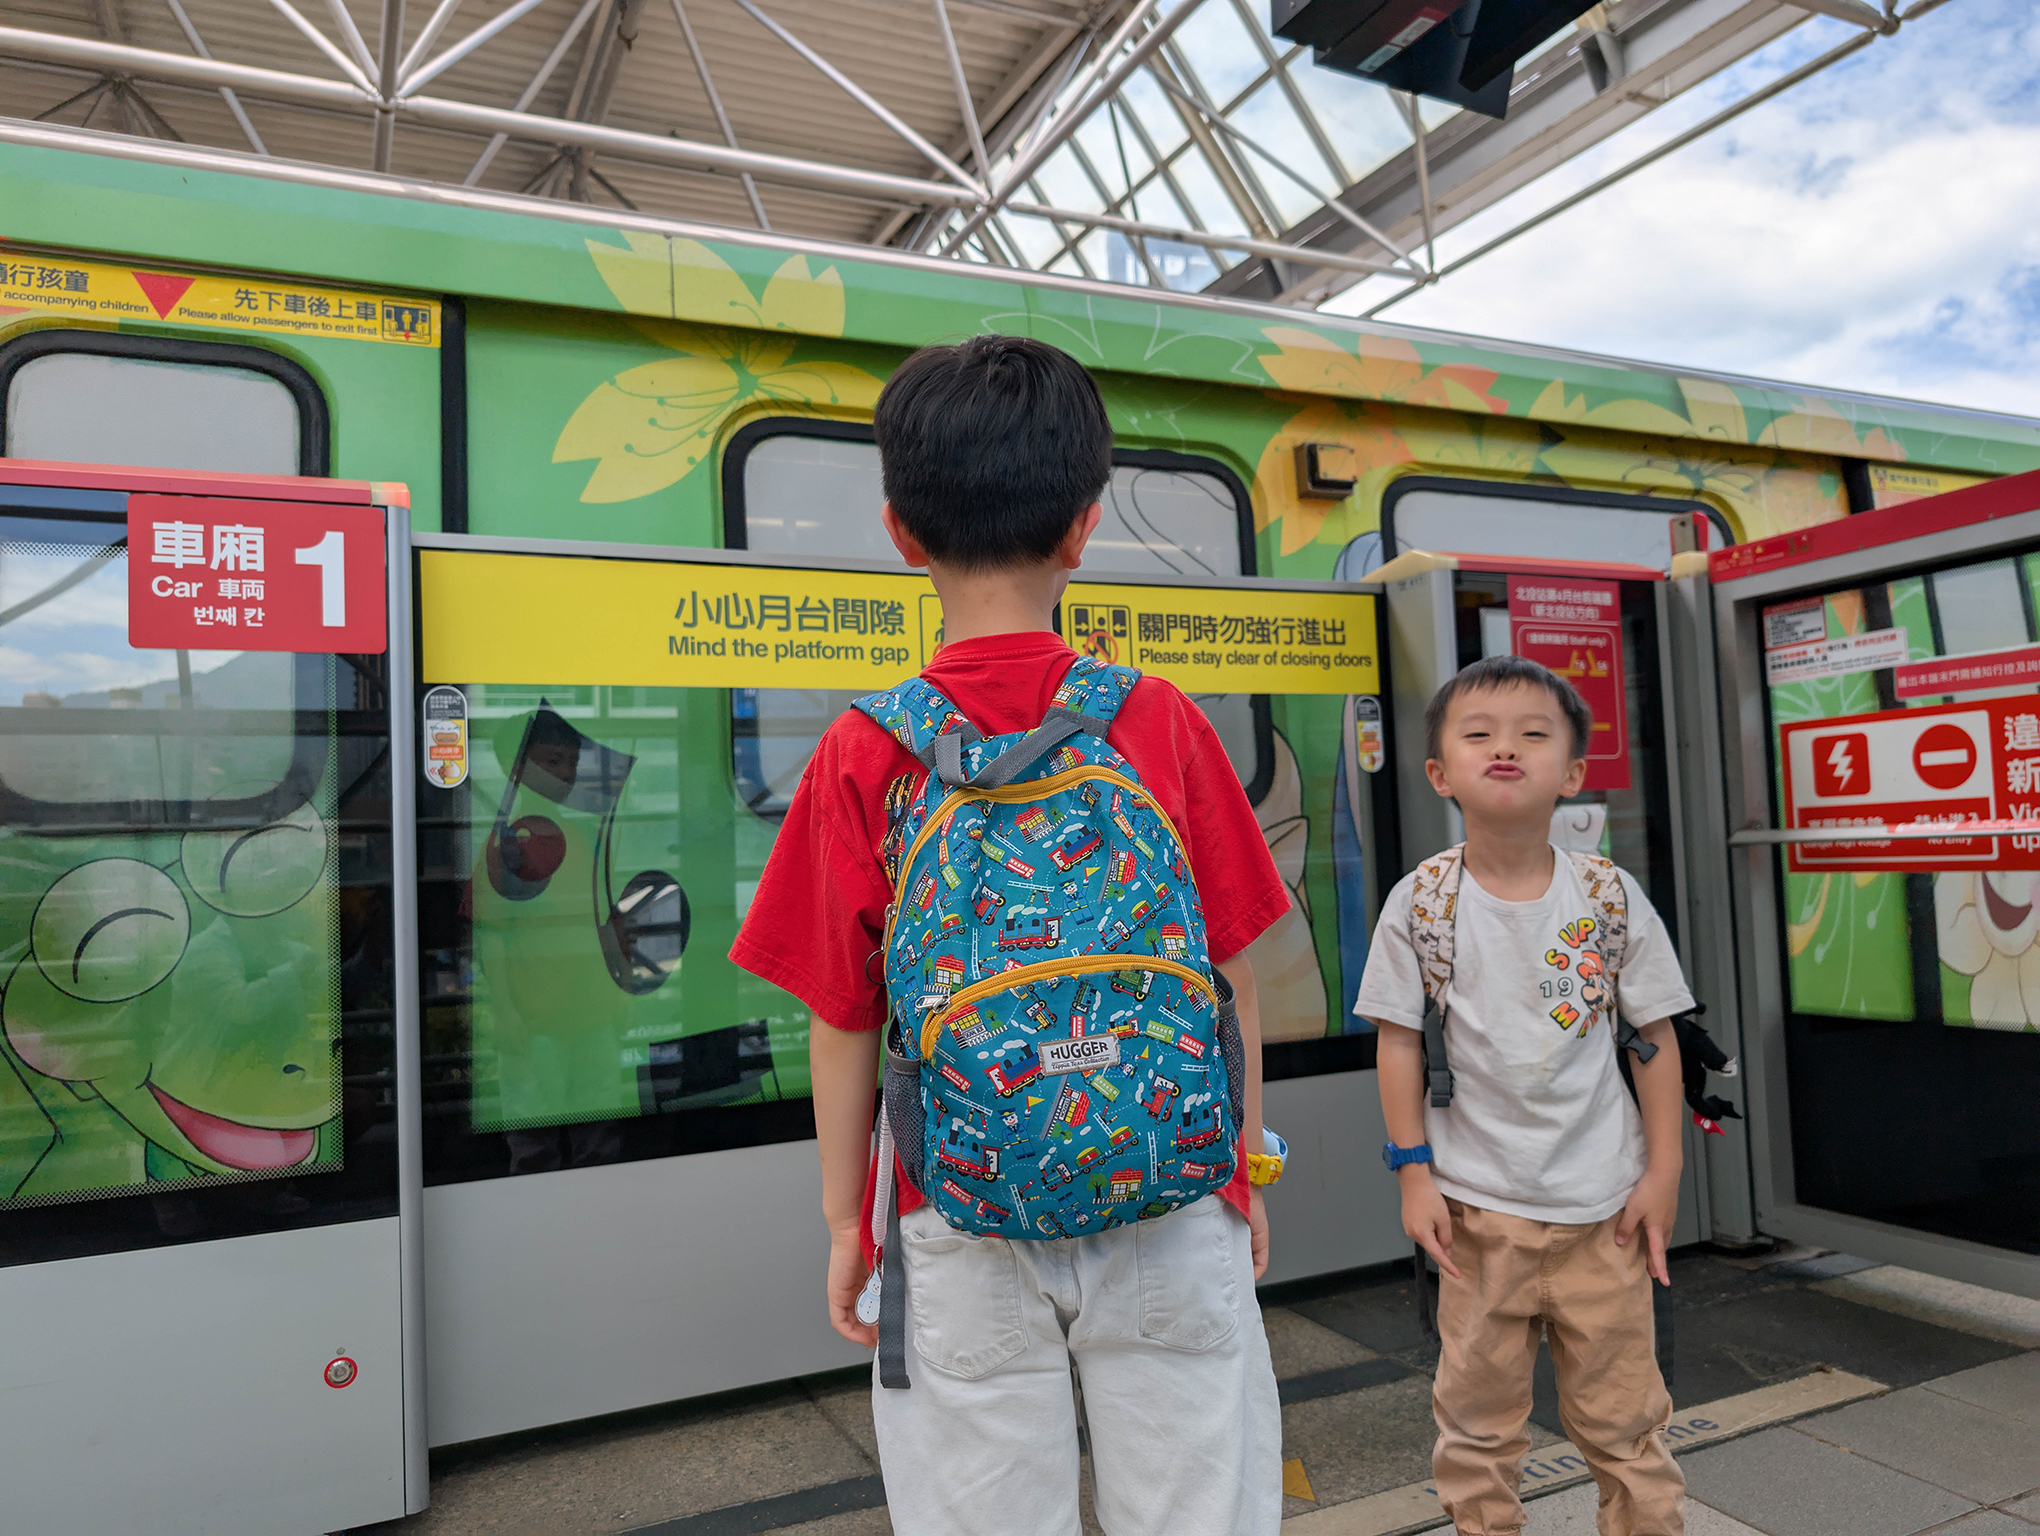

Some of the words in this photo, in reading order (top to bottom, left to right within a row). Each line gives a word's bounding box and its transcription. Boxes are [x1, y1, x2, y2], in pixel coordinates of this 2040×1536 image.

[4, 291, 97, 310] accompanying
[100, 299, 149, 313] children
[235, 288, 377, 321] 先下車後上車
[178, 307, 218, 320] Please
[220, 312, 250, 323] allow
[253, 315, 319, 330] passengers
[322, 322, 333, 331] to
[335, 324, 355, 334] exit
[357, 325, 378, 335] first
[151, 521, 265, 572] 車廂
[151, 575, 203, 598] Car
[218, 578, 265, 601] 車両
[295, 531, 346, 627] 1
[194, 606, 237, 626] 번째
[244, 606, 265, 627] 칸
[675, 591, 906, 636] 小心月台間隙
[1138, 612, 1347, 646] 關門時勿強行進出
[669, 636, 726, 657] Mind
[732, 639, 769, 658] the
[775, 640, 864, 663] platform
[870, 645, 910, 666] gap
[1140, 648, 1189, 664] Please
[1192, 650, 1222, 668] stay
[1226, 650, 1259, 666] clear
[1262, 651, 1278, 666] of
[1280, 651, 1332, 670] closing
[1334, 653, 1372, 668] doors
[2004, 713, 2040, 751] 違
[1050, 1041, 1109, 1060] HUGGER
